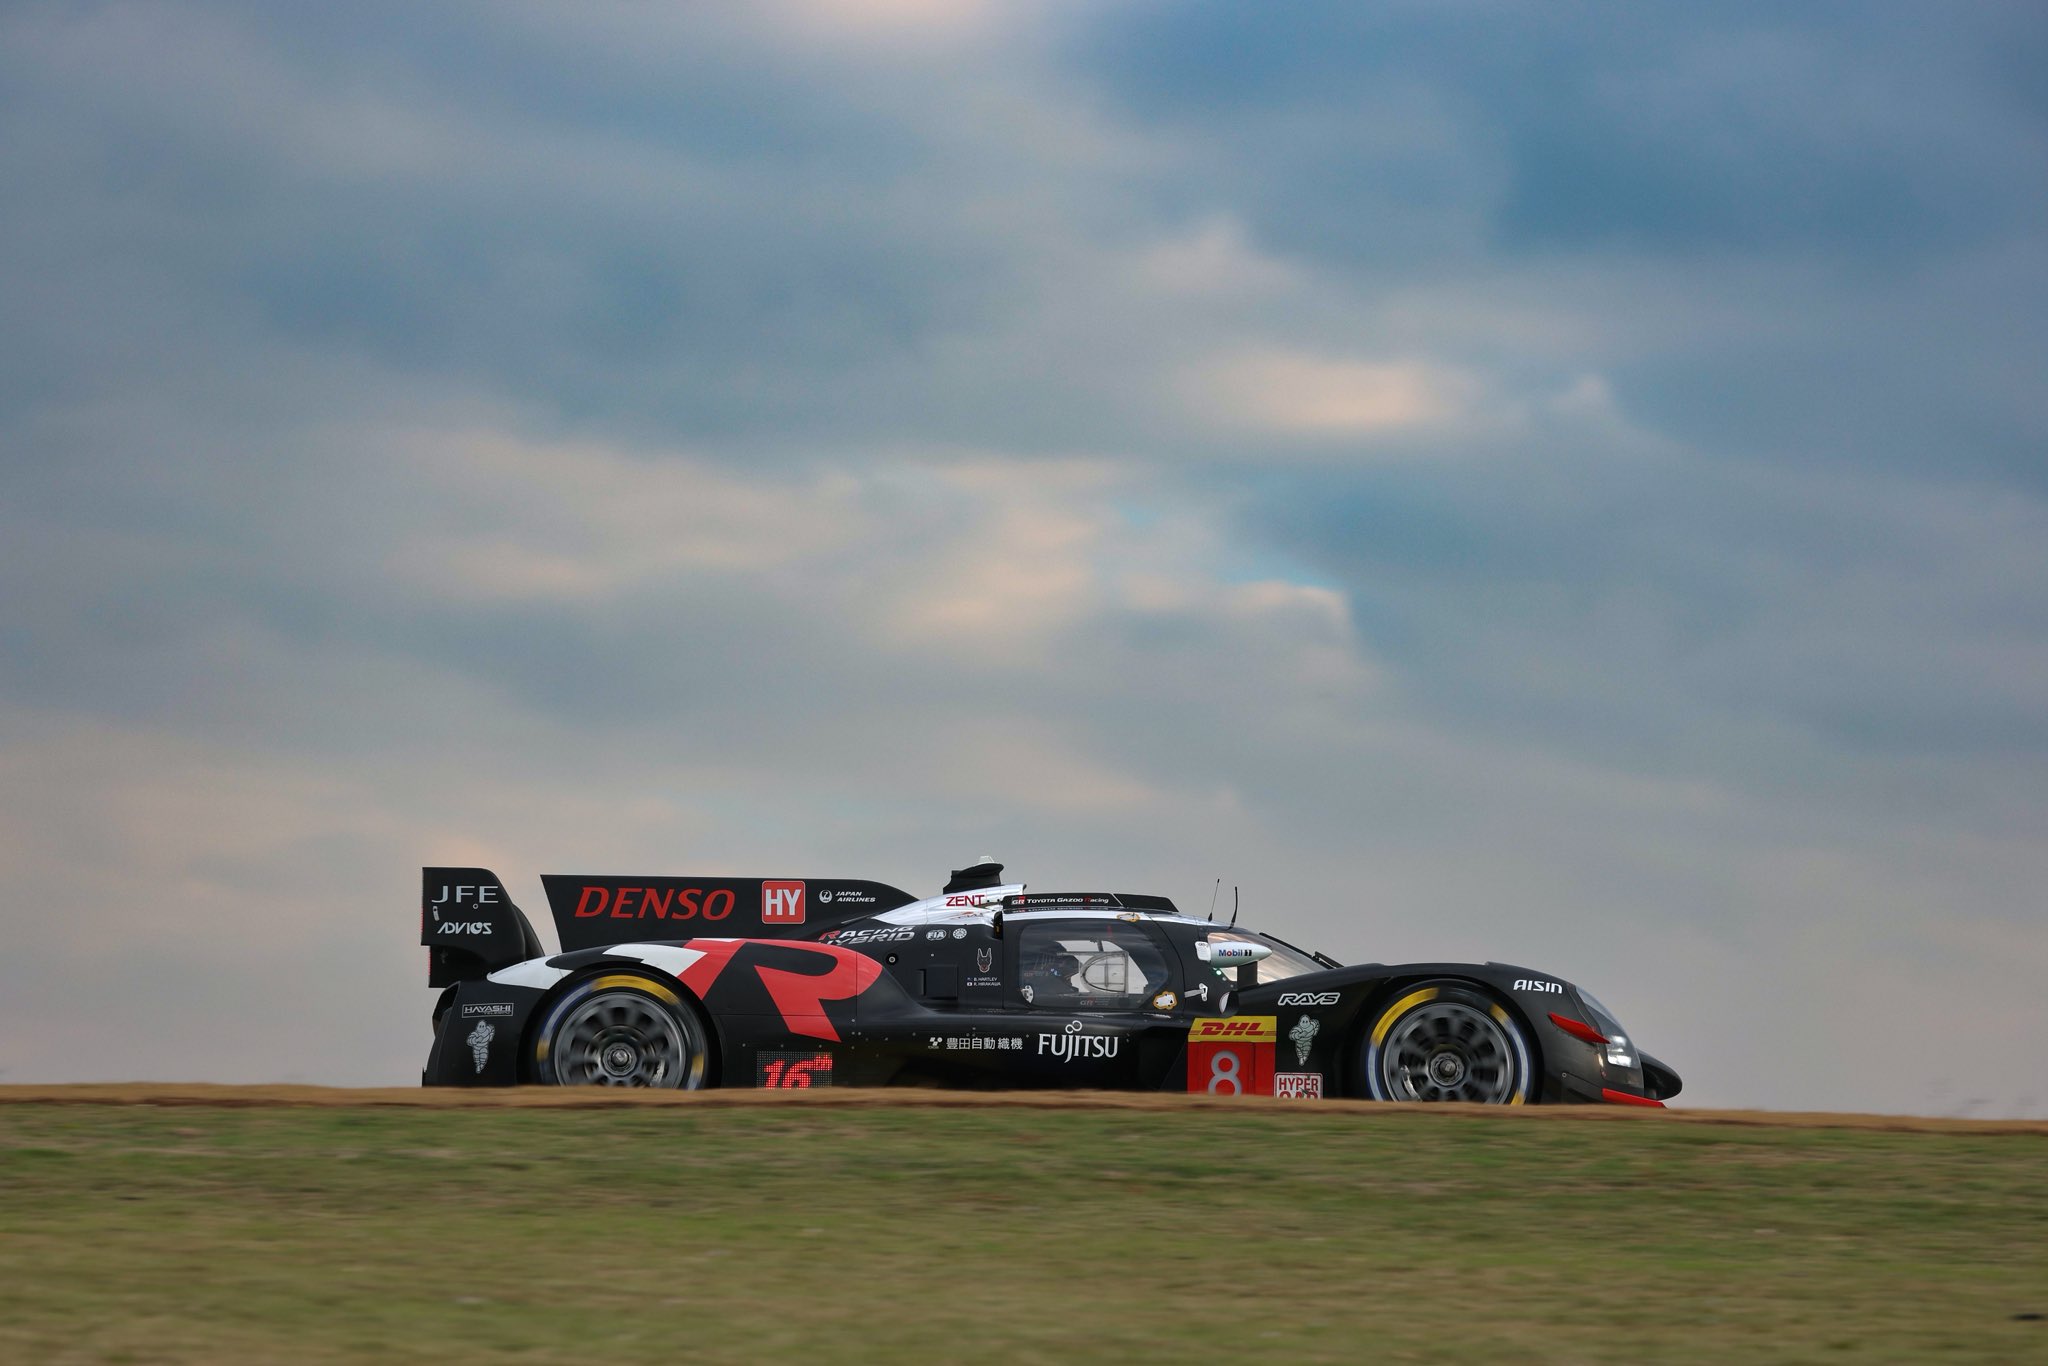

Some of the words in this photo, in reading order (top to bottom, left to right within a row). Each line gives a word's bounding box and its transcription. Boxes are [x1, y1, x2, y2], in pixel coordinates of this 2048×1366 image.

[431, 885, 499, 904] JFE
[945, 895, 985, 907] ZENT
[574, 886, 736, 921] DENSO
[765, 889, 802, 916] HY
[818, 926, 916, 941] RACING
[927, 932, 945, 940] FIA
[1513, 979, 1563, 994] AISIN
[1277, 992, 1341, 1006] RAYS
[463, 1005, 512, 1014] HAYASHI
[1200, 1022, 1265, 1036] DHL
[1037, 1033, 1119, 1064] FUJITSU
[1207, 1050, 1243, 1097] 8
[1279, 1077, 1319, 1091] HYPER
